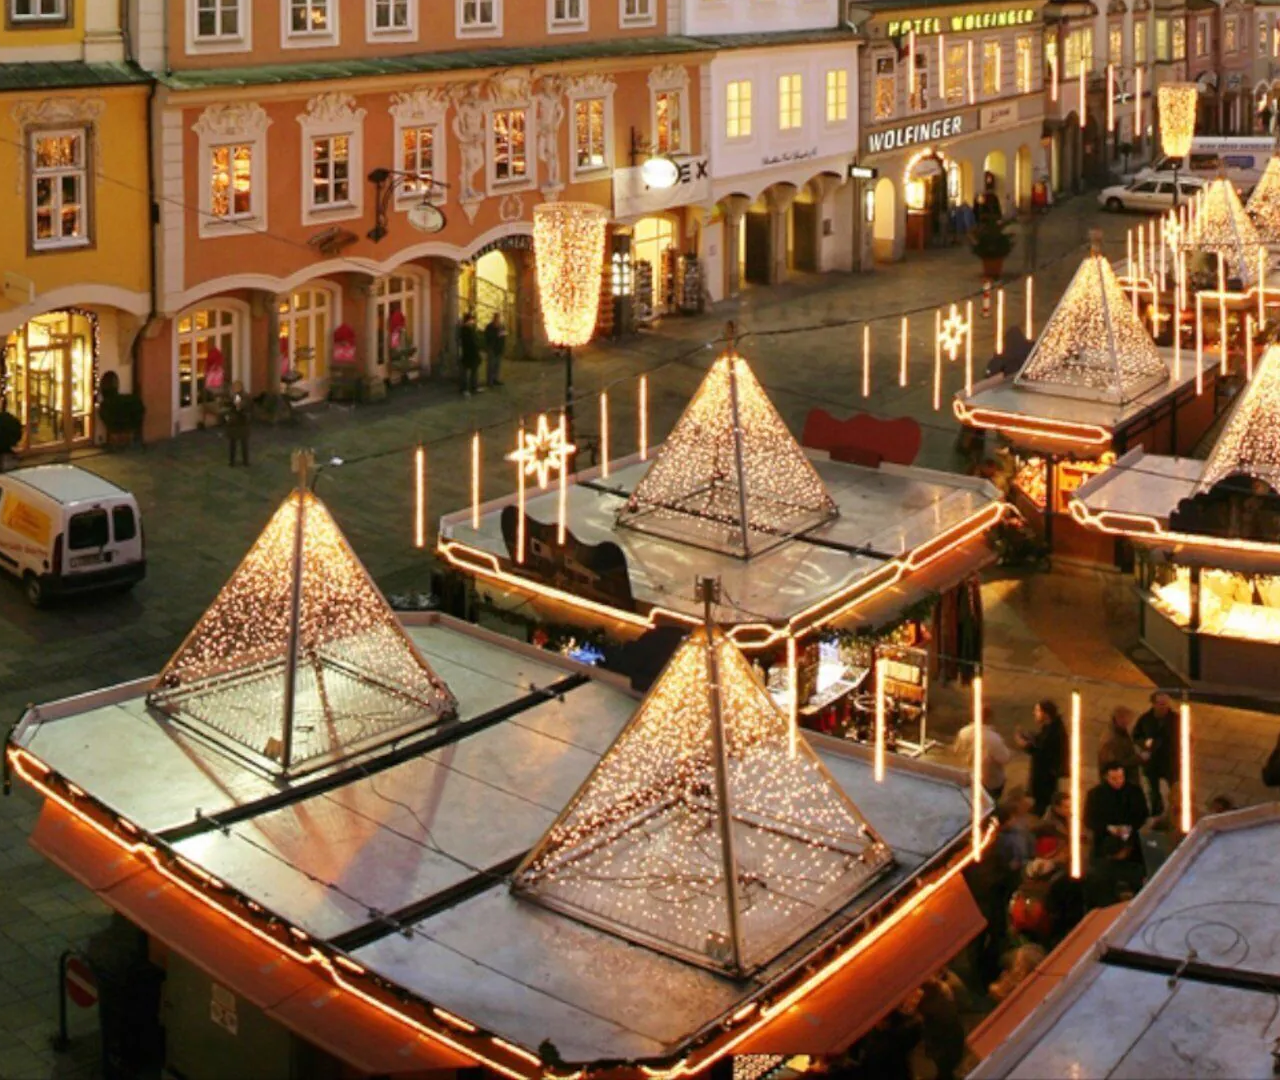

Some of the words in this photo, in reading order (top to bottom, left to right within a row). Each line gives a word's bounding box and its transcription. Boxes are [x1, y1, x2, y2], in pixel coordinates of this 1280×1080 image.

[888, 18, 941, 37] HOTEL
[951, 9, 1034, 31] WOLFINGER
[868, 115, 963, 153] WOLFINGER
